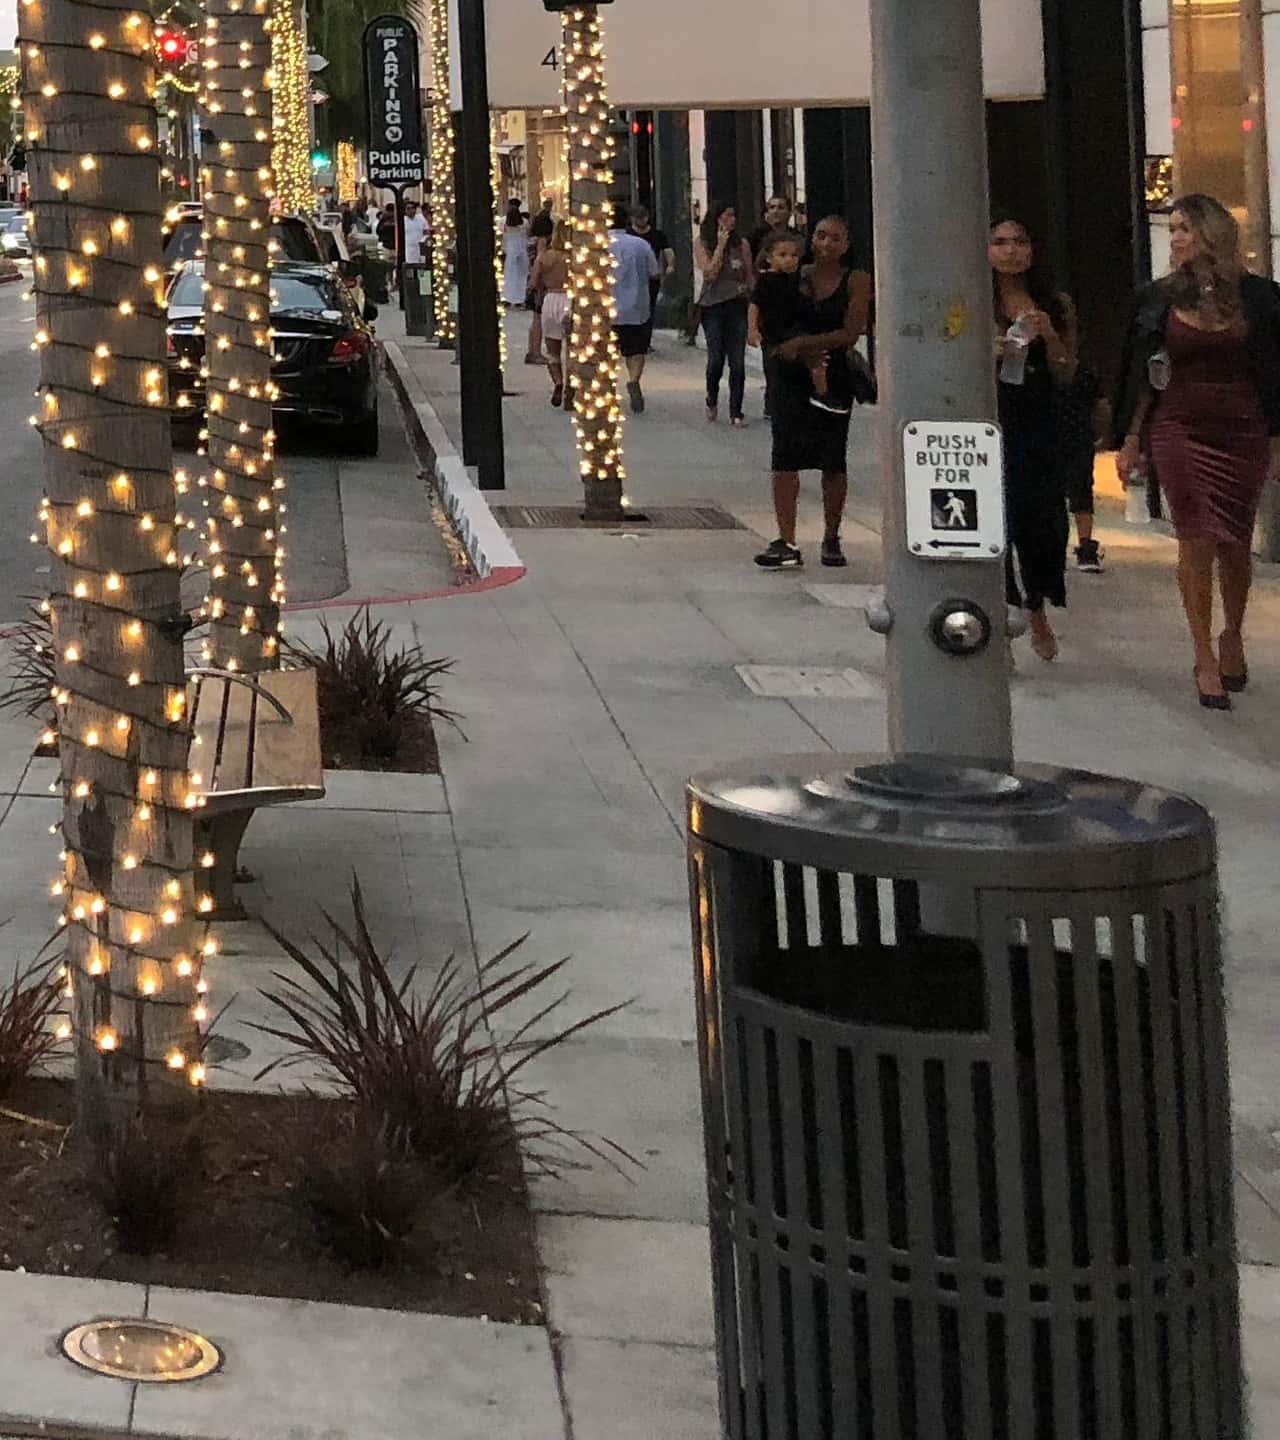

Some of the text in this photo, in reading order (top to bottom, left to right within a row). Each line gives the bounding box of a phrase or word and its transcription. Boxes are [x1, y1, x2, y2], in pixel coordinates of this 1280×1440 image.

[376, 27, 404, 38] PUBLIC
[383, 38, 401, 124] PARKING
[369, 150, 420, 165] Public
[370, 166, 422, 180] Parking
[927, 435, 976, 448] PUSH
[916, 451, 988, 466] BUTTON
[935, 468, 970, 483] FOR
